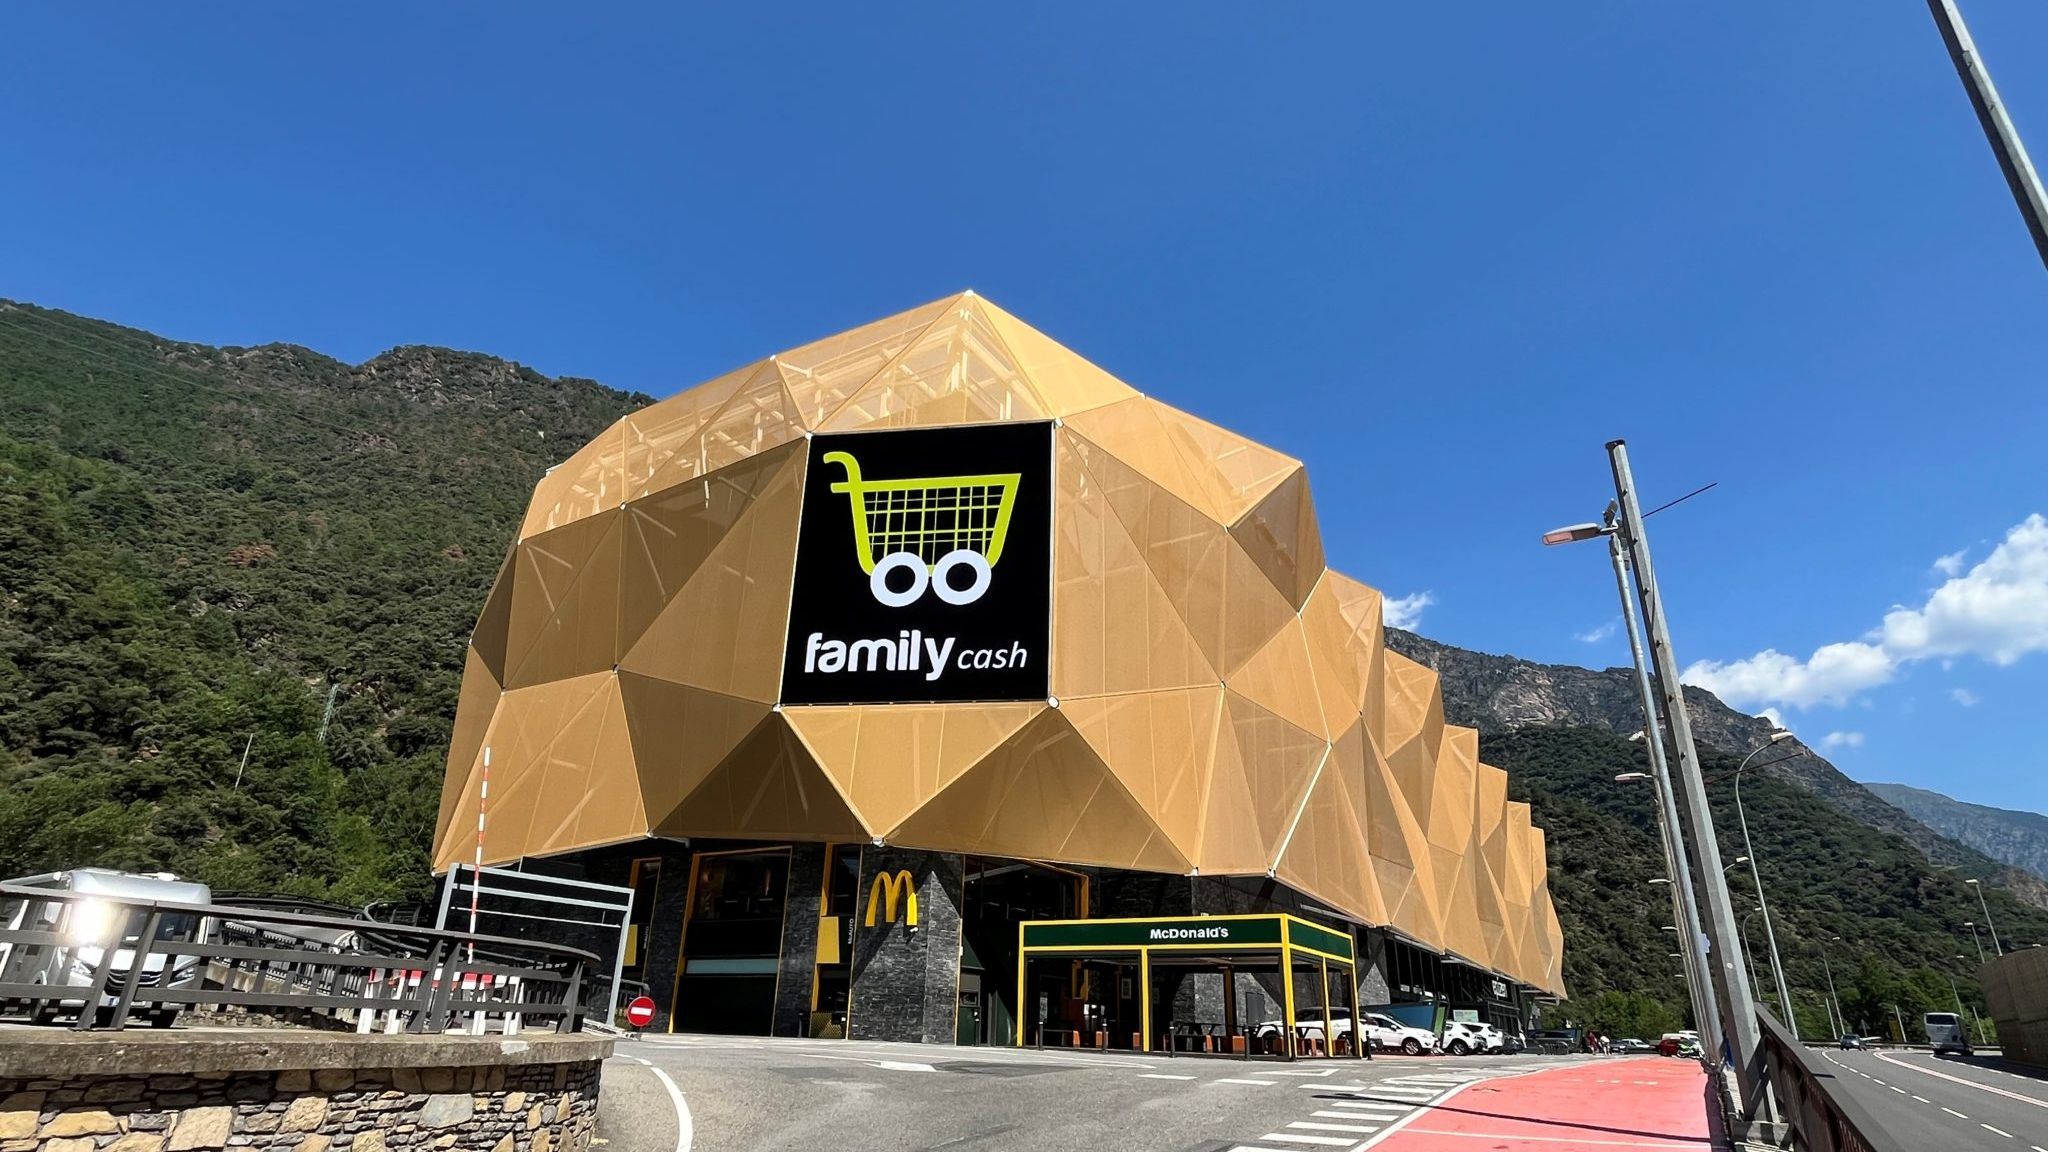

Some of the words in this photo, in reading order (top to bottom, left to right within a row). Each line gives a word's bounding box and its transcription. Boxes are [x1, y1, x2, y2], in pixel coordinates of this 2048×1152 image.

[804, 629, 956, 682] family
[957, 641, 1028, 670] cash
[1150, 926, 1229, 940] McDonald's
